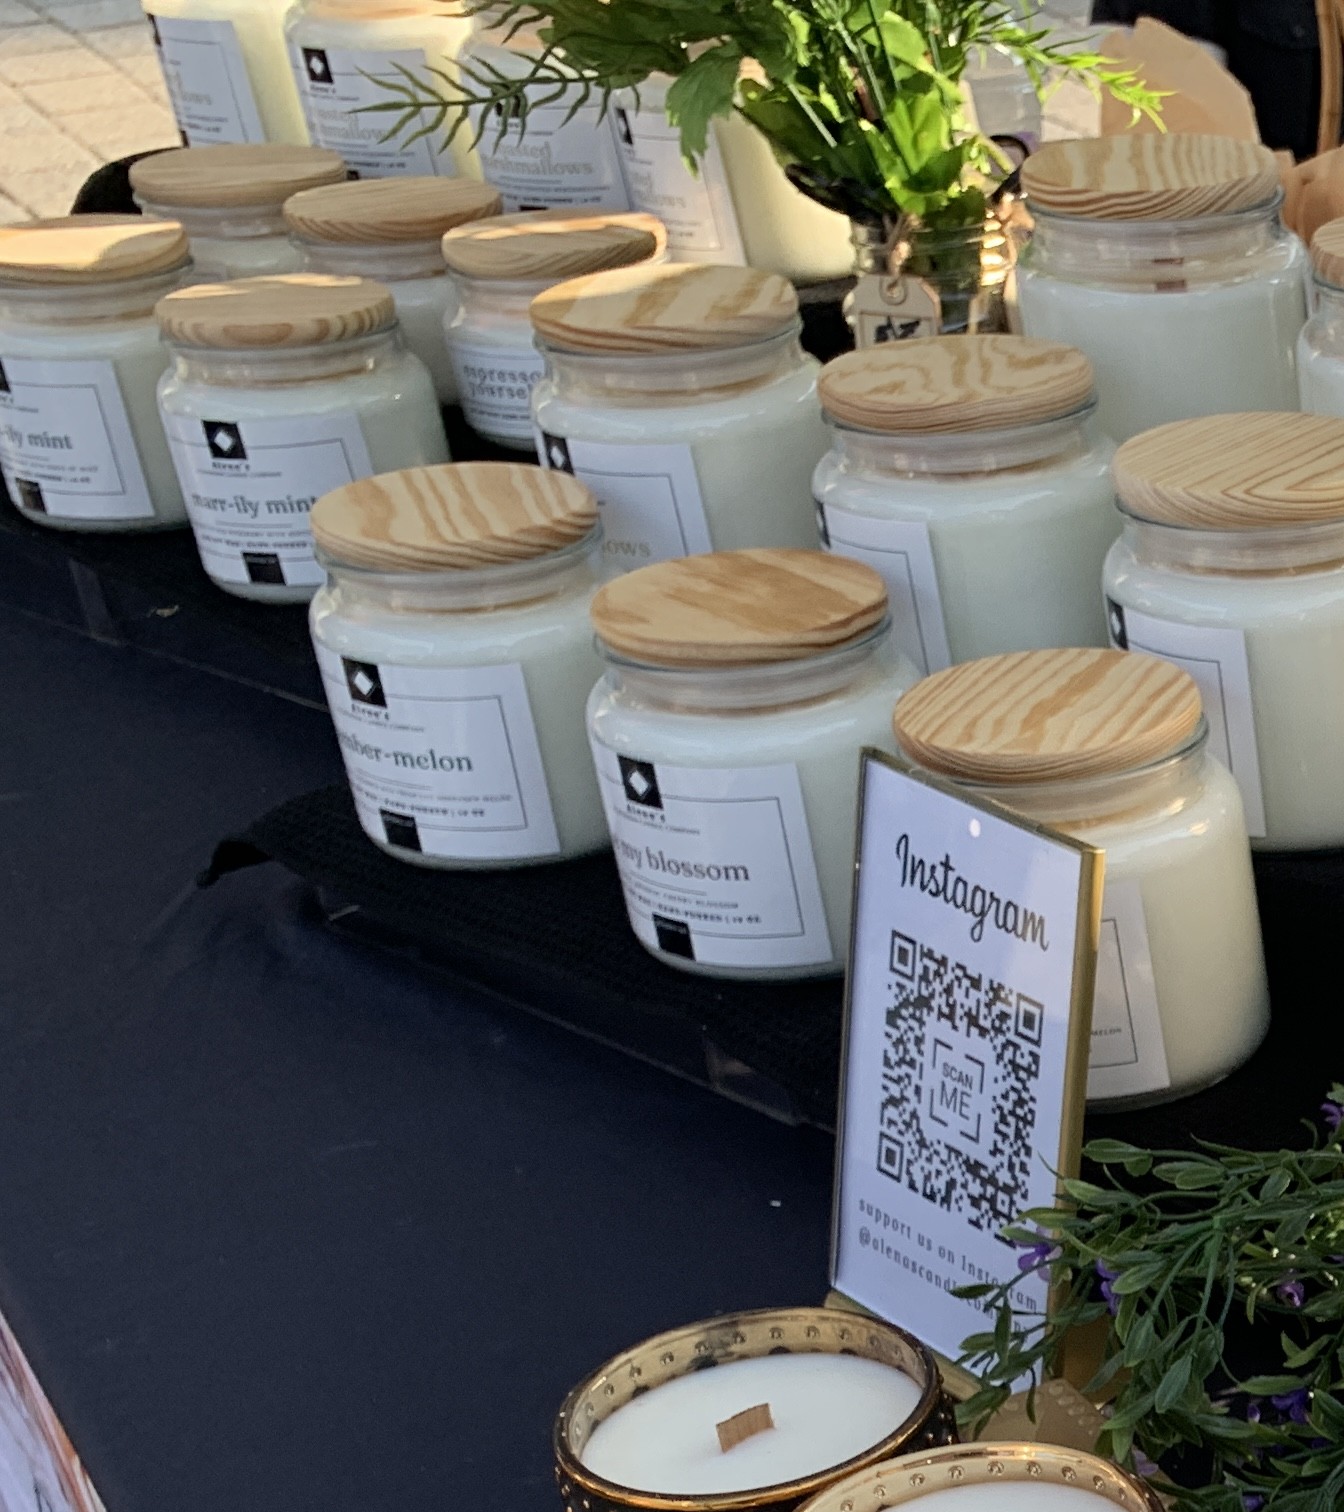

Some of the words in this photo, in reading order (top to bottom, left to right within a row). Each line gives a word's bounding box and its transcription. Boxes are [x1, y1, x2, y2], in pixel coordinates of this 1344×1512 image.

[646, 846, 751, 882] blossom
[896, 833, 1049, 952] Instagram
[942, 1061, 974, 1091] SCAN
[939, 1080, 973, 1122] ME
[858, 1198, 912, 1240] support
[917, 1232, 933, 1252] us
[938, 1245, 955, 1265] on
[961, 1254, 1038, 1314] Instaram
